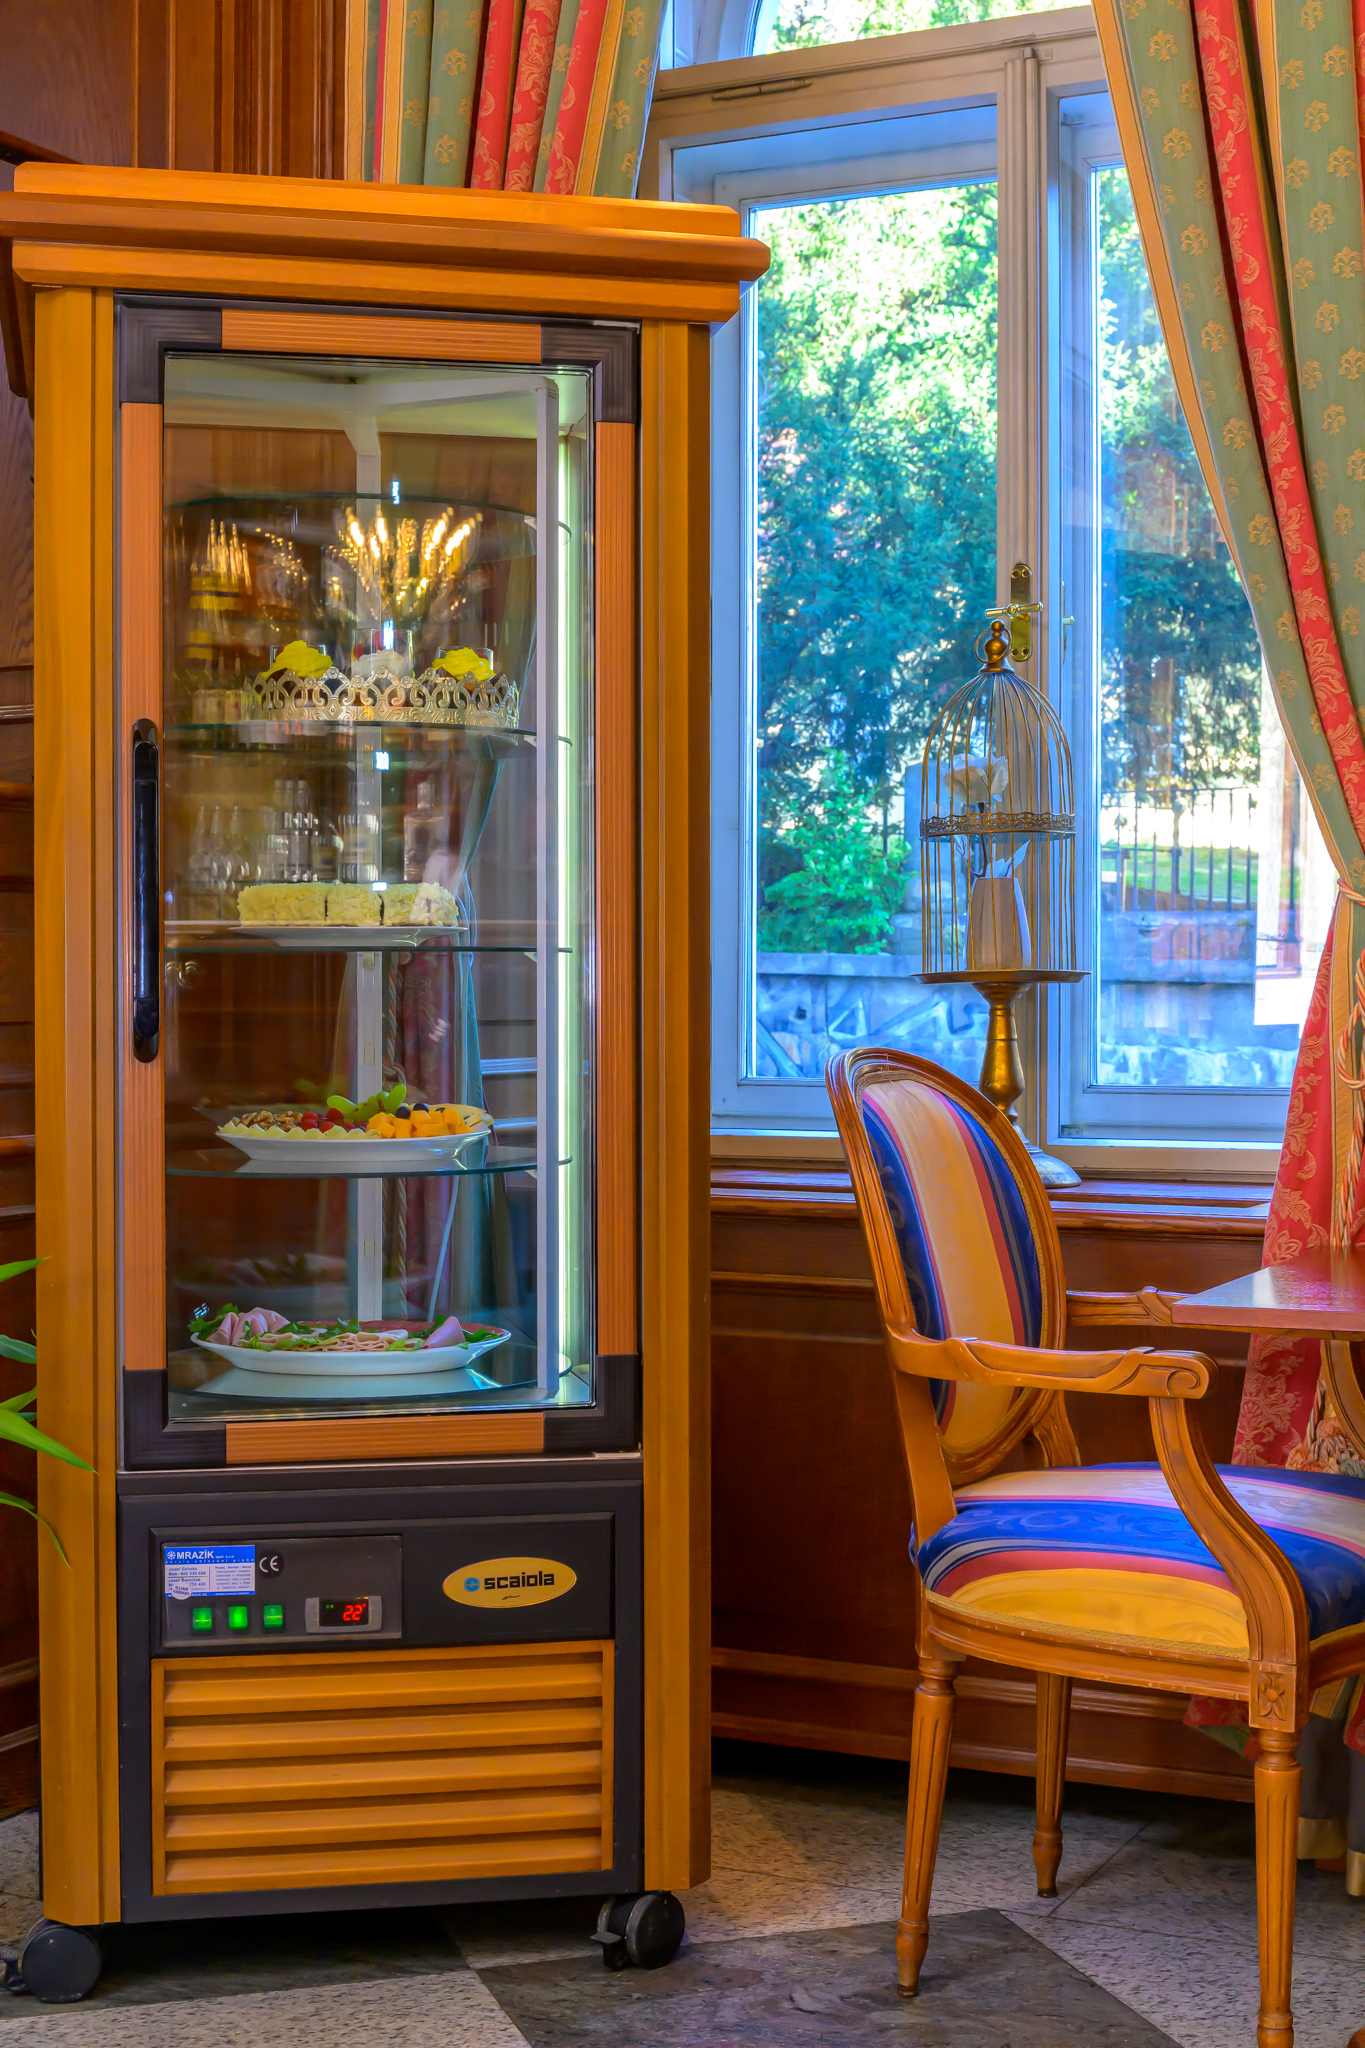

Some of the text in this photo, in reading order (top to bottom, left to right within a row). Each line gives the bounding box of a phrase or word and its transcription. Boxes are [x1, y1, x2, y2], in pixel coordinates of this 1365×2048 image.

[176, 1549, 214, 1560] MRAZÍK
[259, 1555, 280, 1573] CE
[484, 1570, 555, 1590] scaiola
